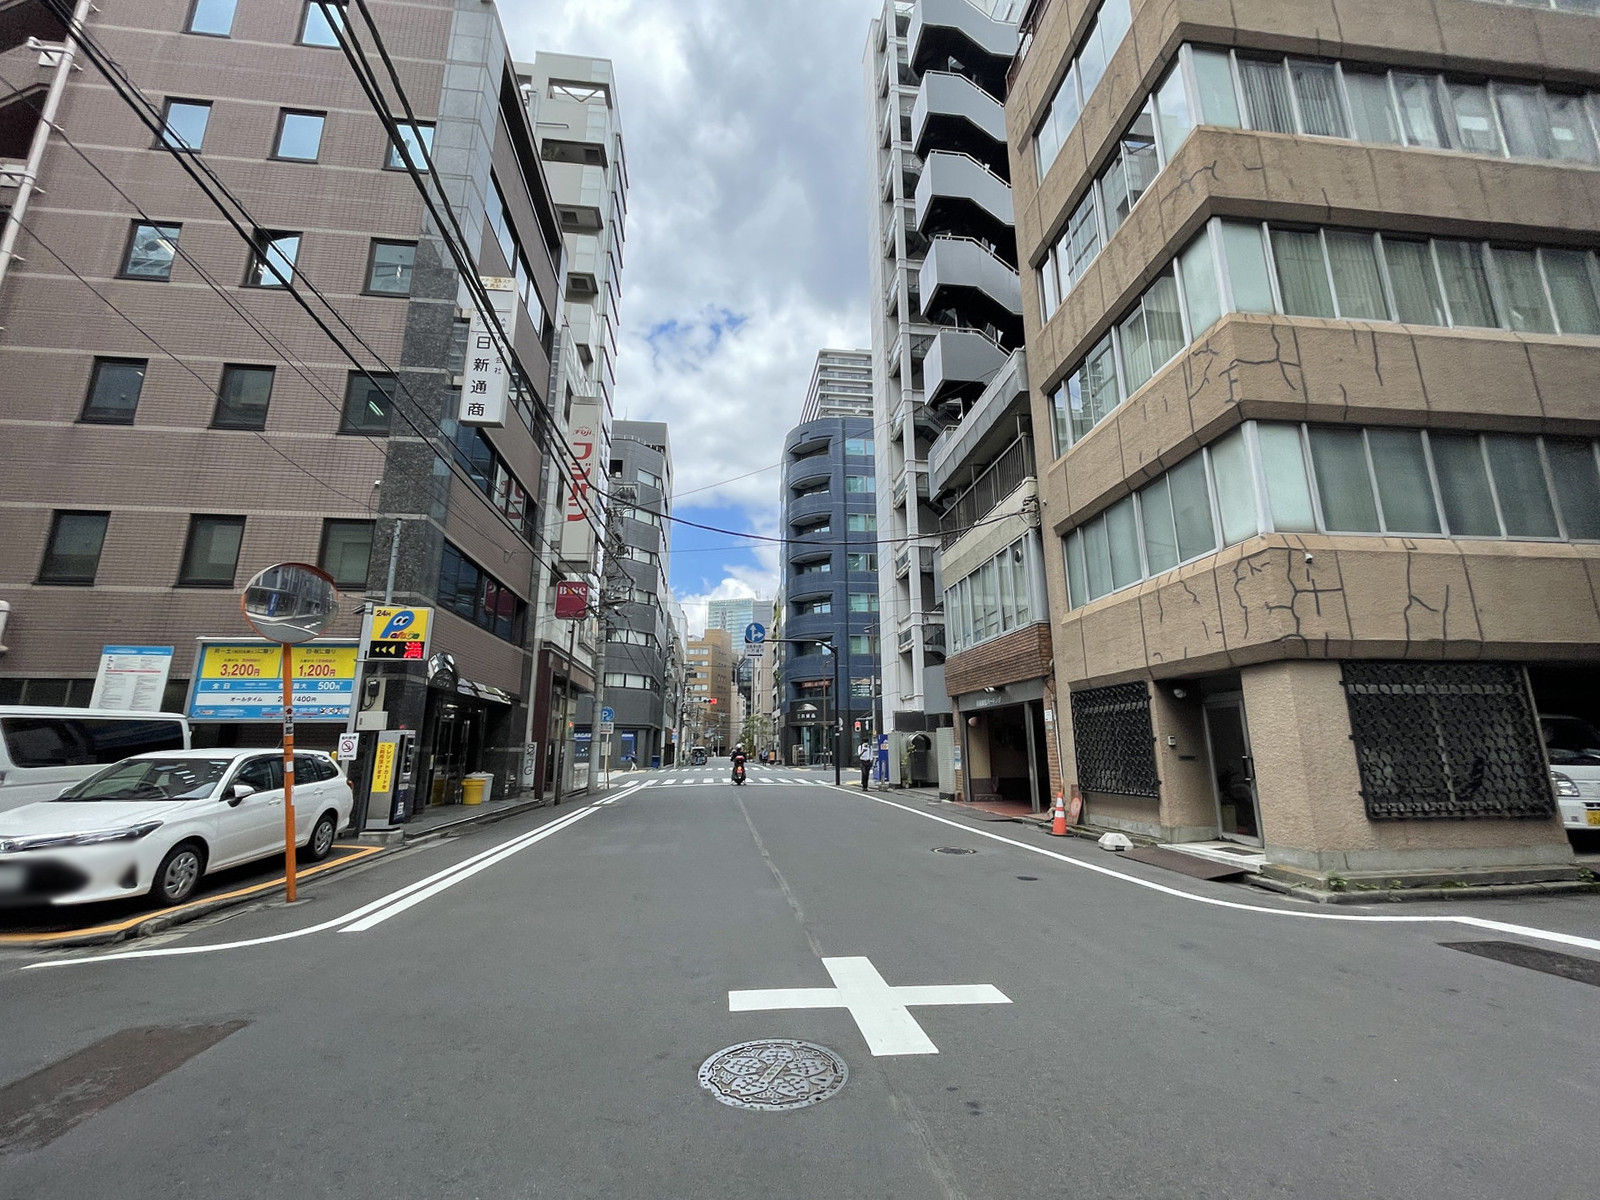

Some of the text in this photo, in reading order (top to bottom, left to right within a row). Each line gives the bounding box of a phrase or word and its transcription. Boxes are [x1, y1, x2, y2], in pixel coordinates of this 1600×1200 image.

[467, 335, 491, 417] 日新通商
[567, 441, 593, 522] フジパン
[403, 641, 422, 659] 満
[220, 664, 260, 677] 3,200円
[298, 665, 336, 677] 1,200円
